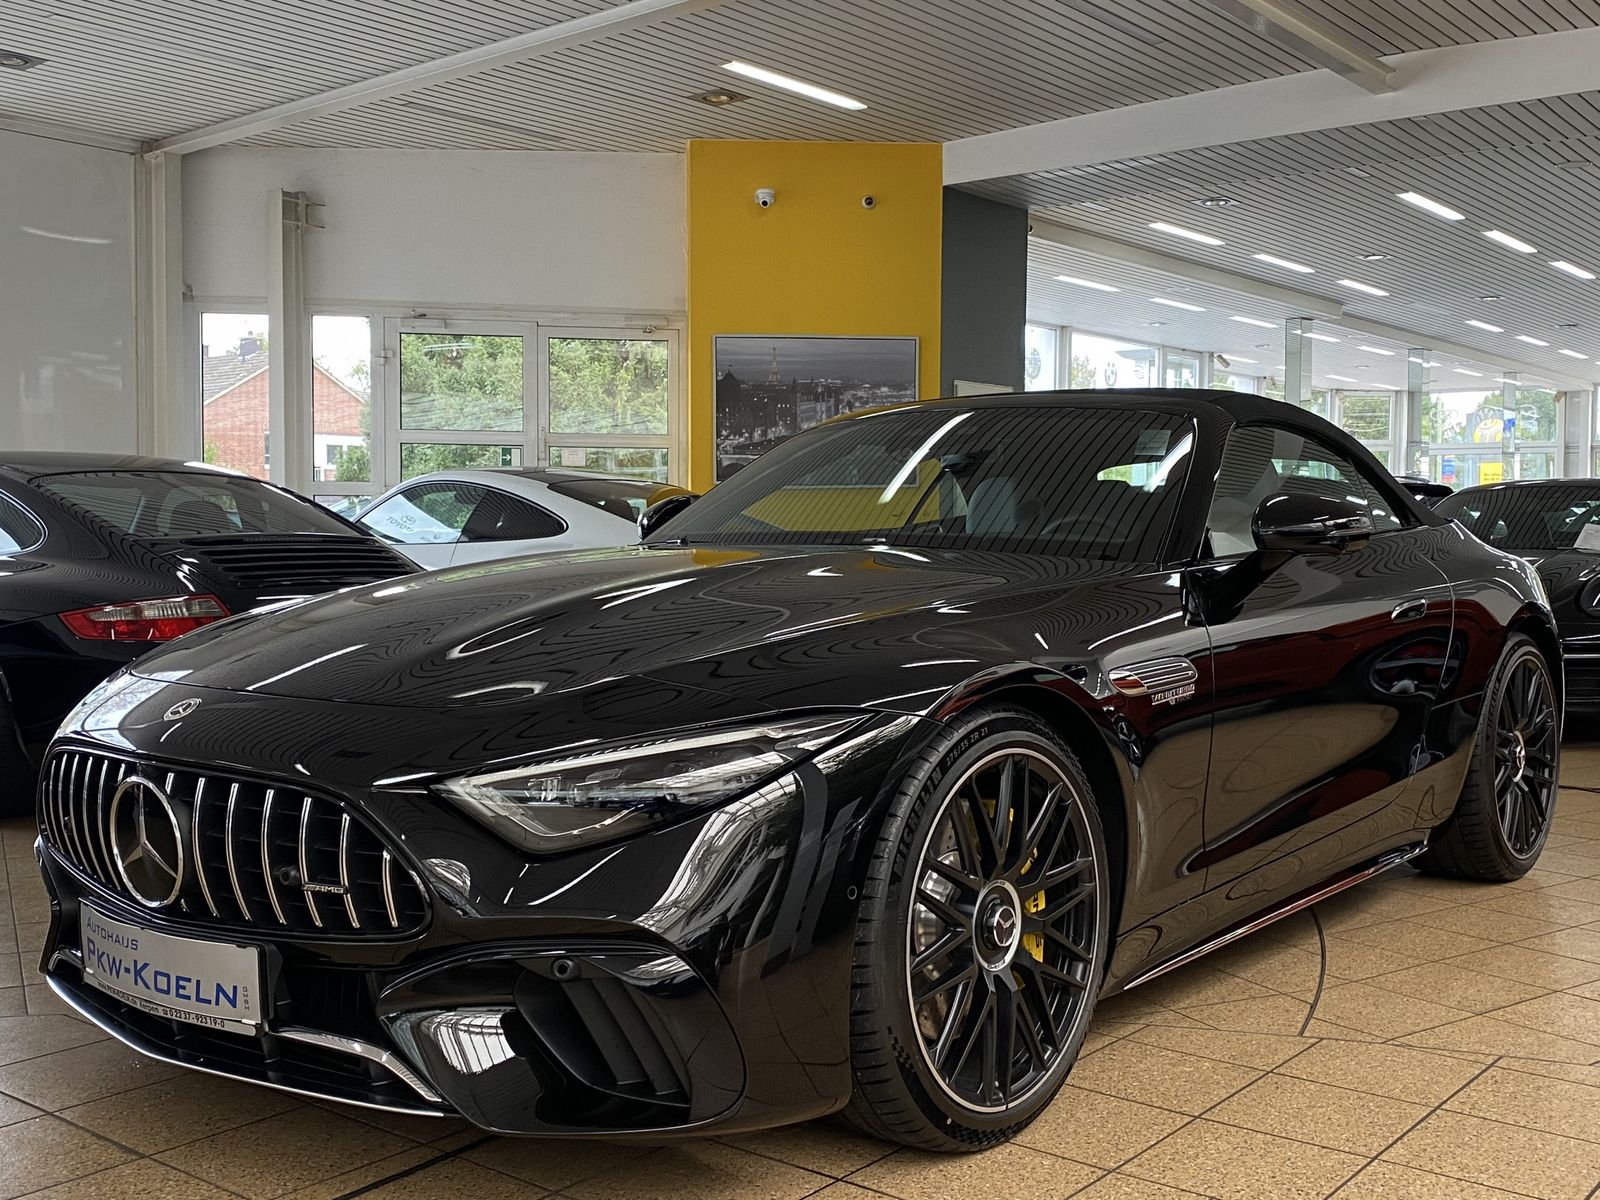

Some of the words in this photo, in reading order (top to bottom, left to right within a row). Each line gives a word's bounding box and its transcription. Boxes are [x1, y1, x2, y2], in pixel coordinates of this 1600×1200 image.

[945, 739, 969, 767] 275/35
[970, 731, 980, 744] ZR
[981, 726, 989, 738] 21
[893, 767, 943, 880] MICHELIN
[86, 916, 139, 951] AUTOHAUS
